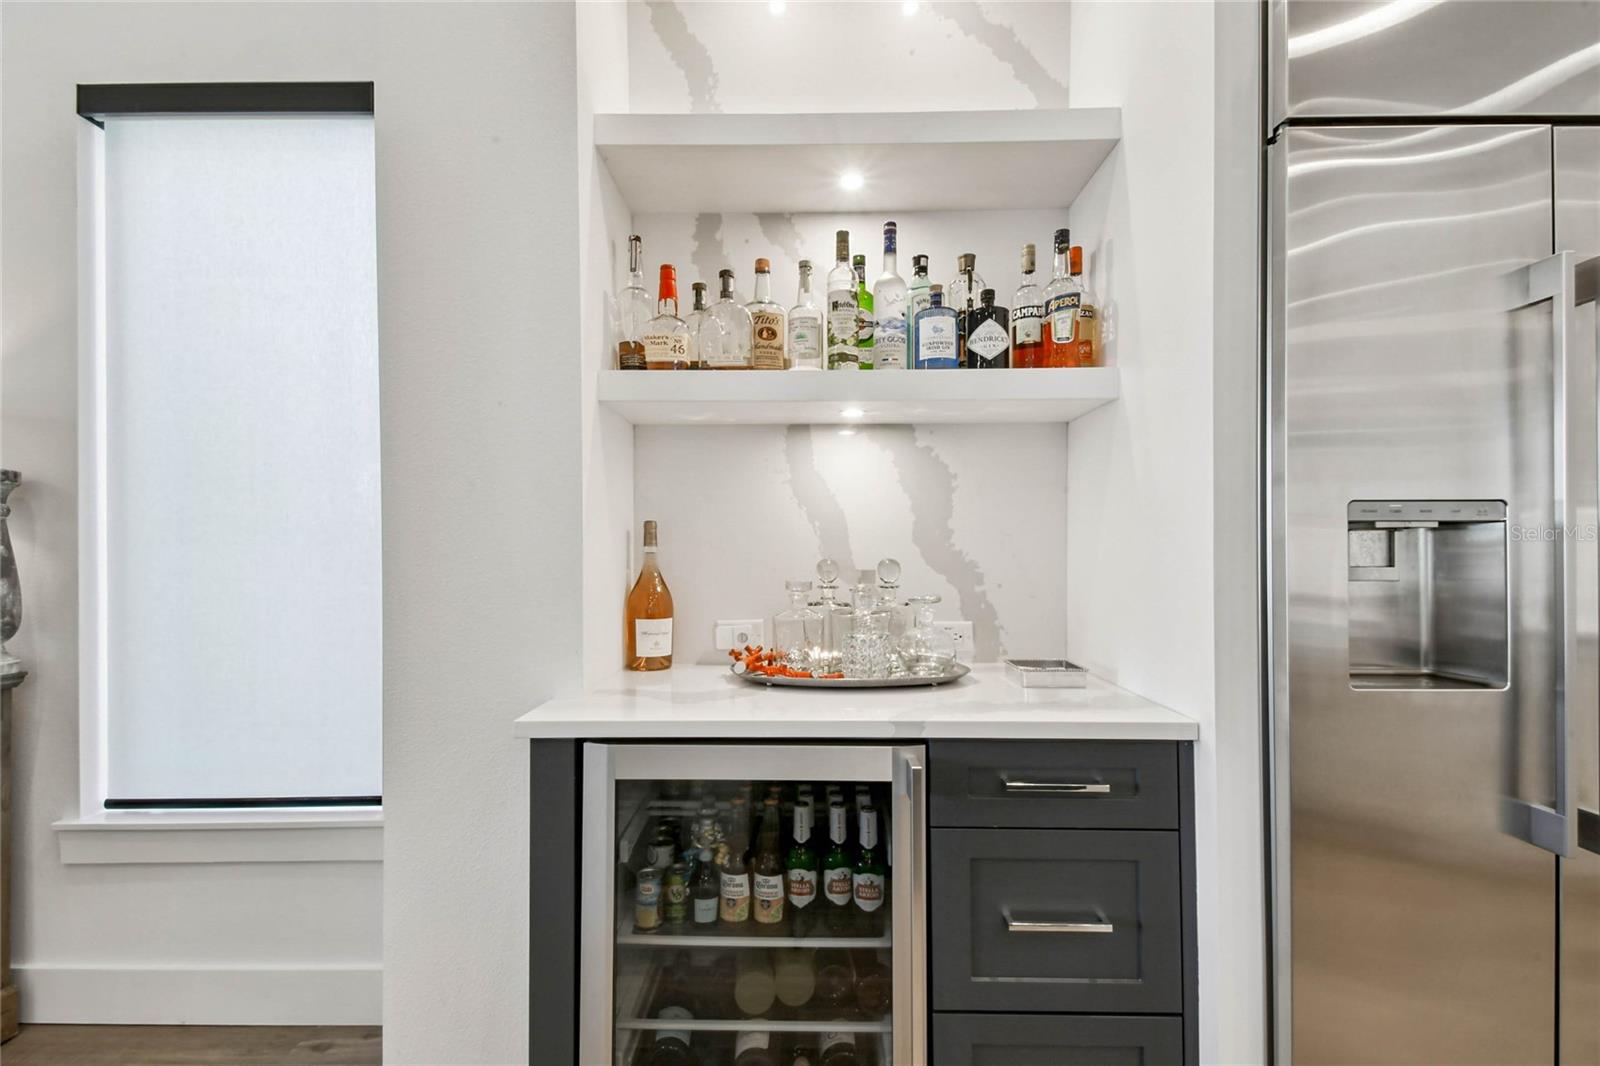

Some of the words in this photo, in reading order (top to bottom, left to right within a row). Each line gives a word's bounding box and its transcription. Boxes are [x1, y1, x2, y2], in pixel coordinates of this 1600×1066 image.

[1047, 295, 1079, 313] APEROL
[754, 315, 780, 325] Tito's
[670, 344, 686, 355] 46
